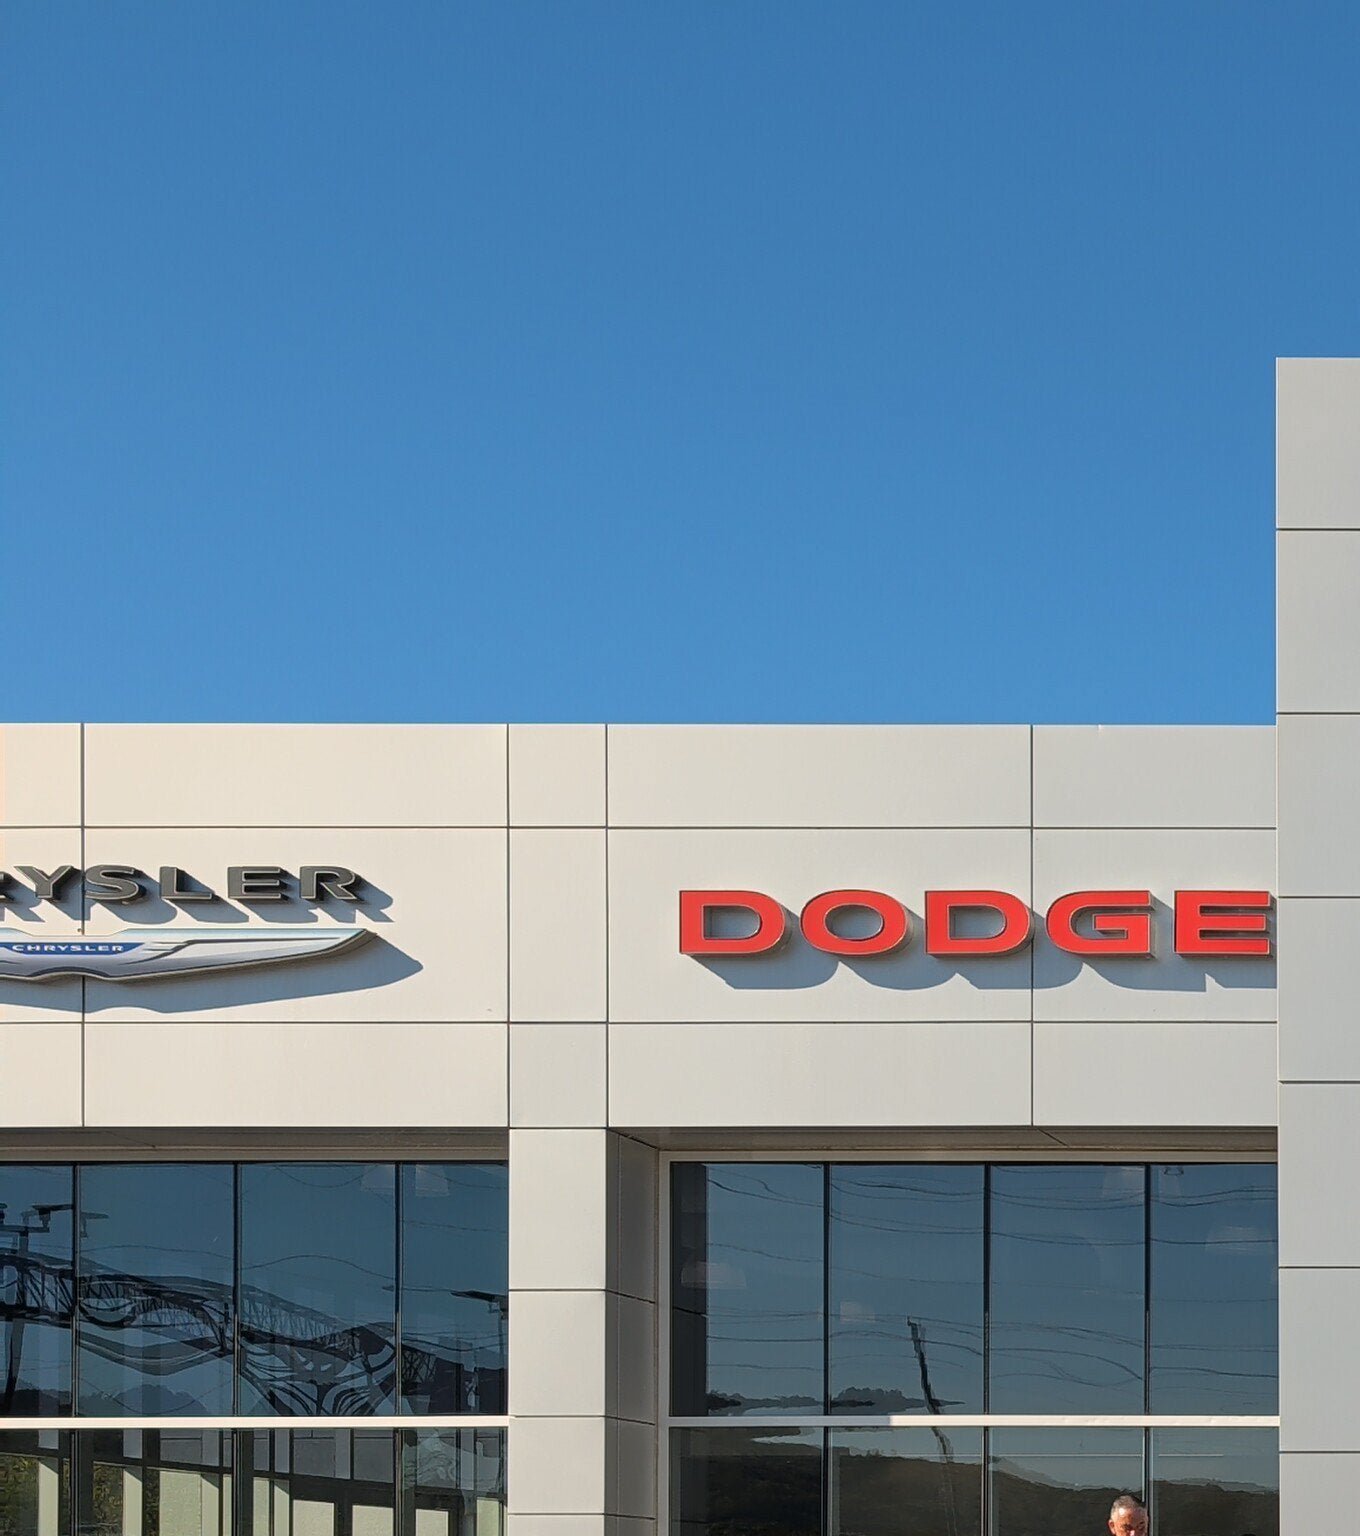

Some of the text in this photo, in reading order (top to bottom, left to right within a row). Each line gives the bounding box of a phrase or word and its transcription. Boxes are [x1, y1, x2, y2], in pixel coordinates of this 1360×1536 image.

[0, 865, 360, 901] YSLER
[679, 889, 1276, 960] DODGE
[12, 944, 124, 953] CHRYSLER
